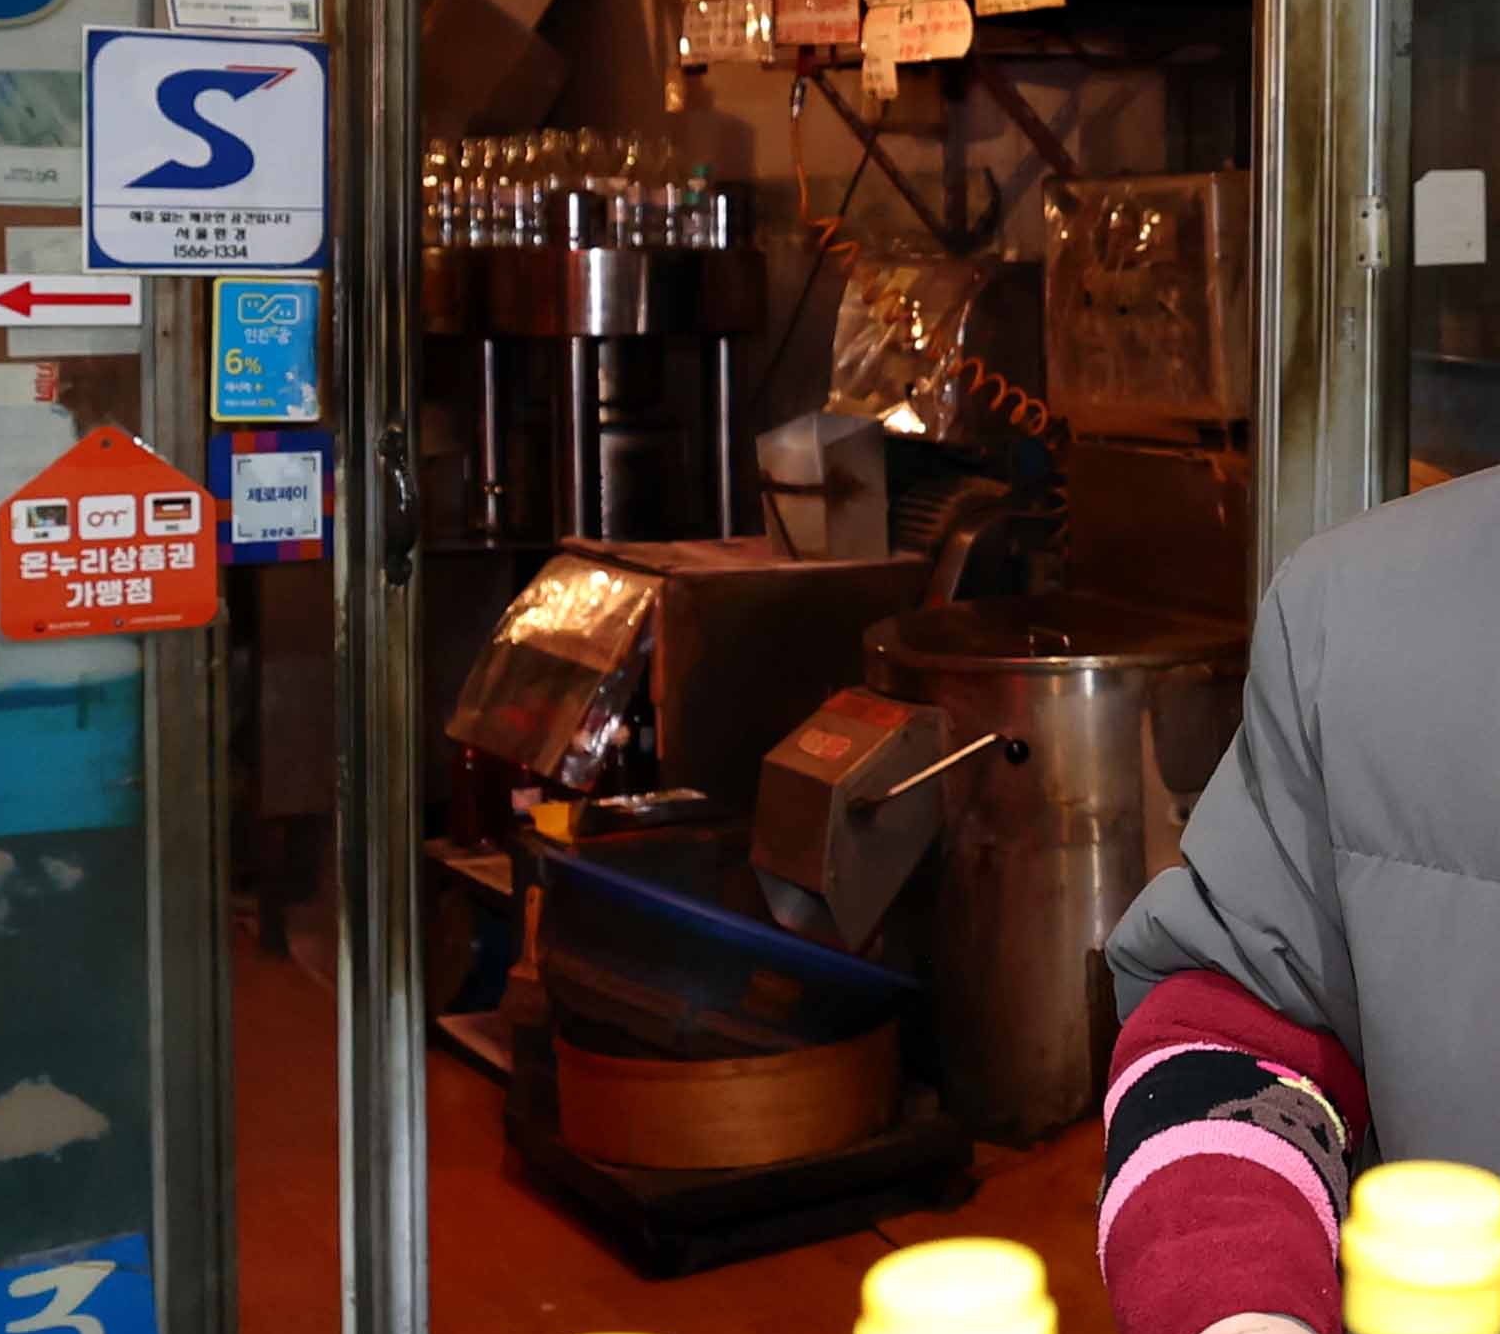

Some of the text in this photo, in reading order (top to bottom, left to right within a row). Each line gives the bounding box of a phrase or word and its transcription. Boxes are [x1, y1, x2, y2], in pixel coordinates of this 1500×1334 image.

[173, 244, 249, 259] 1566-1334
[224, 348, 263, 375] 6%
[246, 485, 309, 504] 제로페이
[18, 541, 196, 580] 온누리상품권
[65, 577, 152, 609] 가맹점
